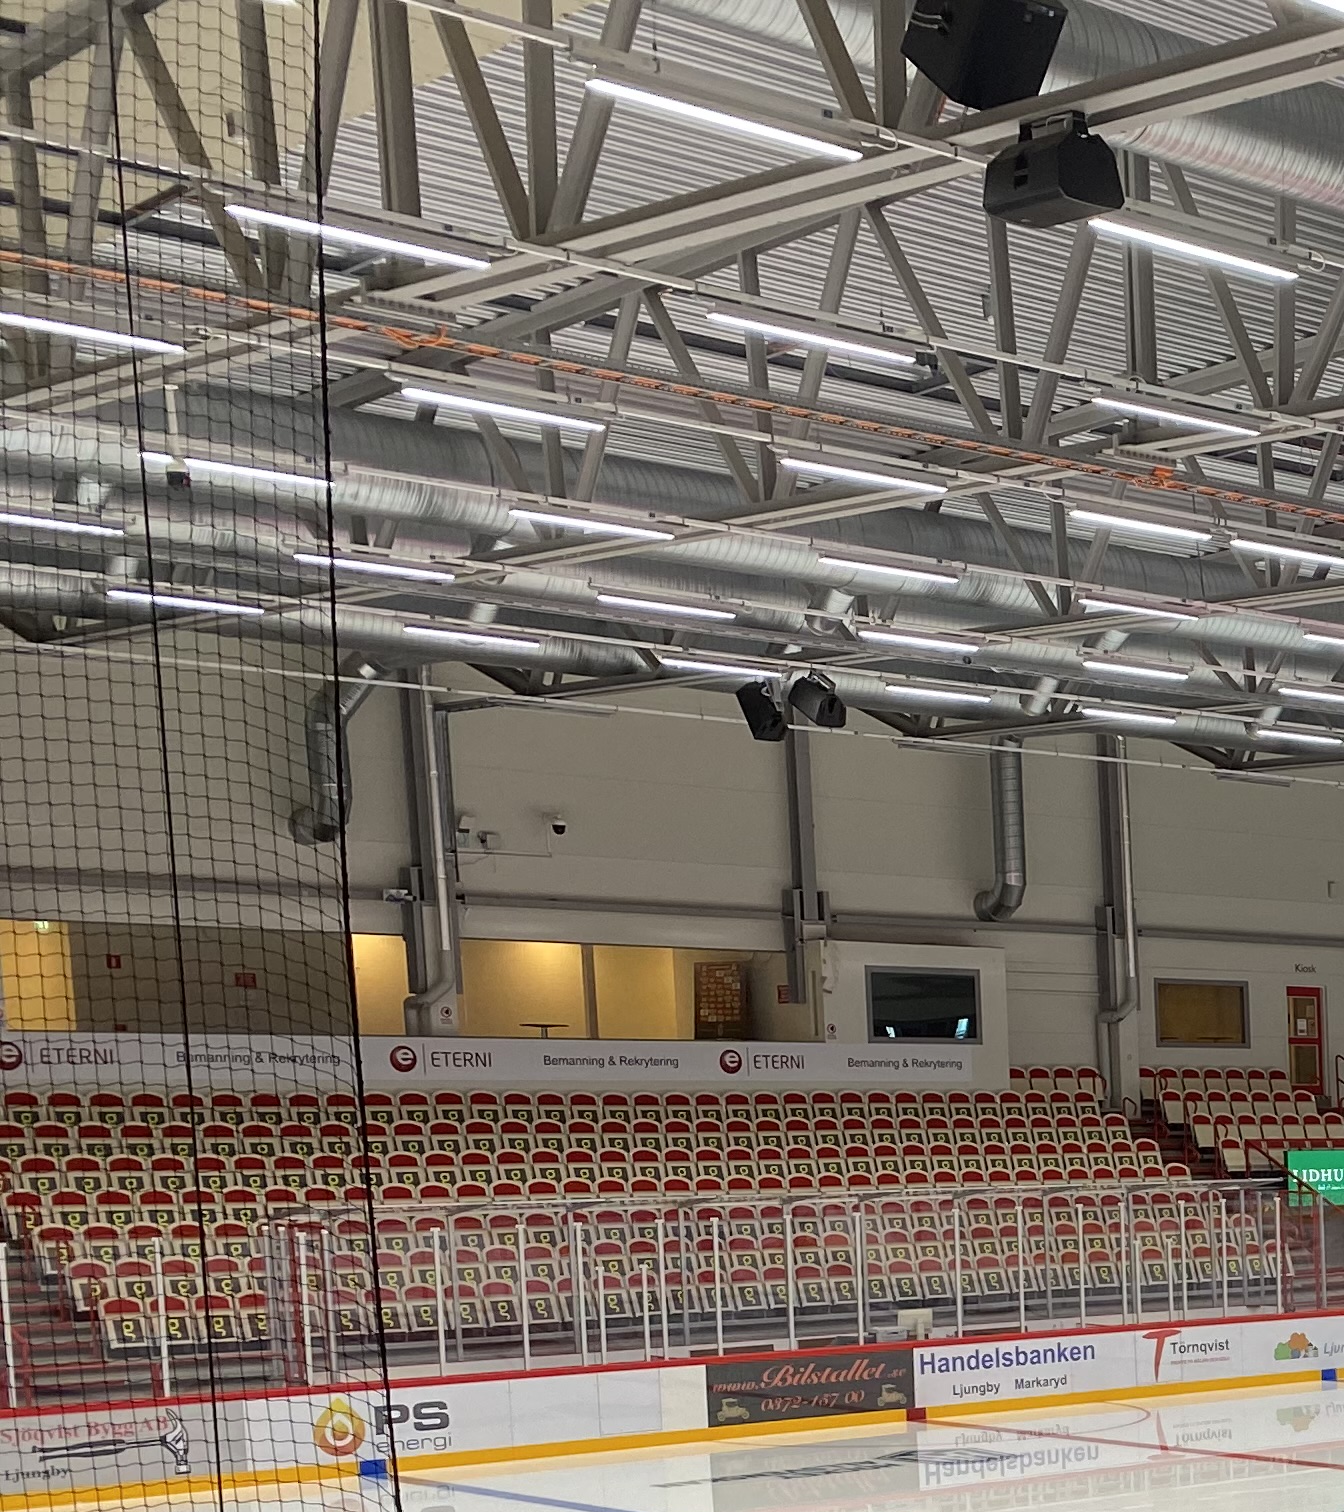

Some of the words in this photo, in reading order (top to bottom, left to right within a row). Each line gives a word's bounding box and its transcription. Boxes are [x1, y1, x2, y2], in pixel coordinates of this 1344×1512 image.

[1294, 964, 1317, 973] Kiosk
[40, 1048, 114, 1065] ETERNI
[254, 1052, 265, 1065] &
[430, 1050, 493, 1069] ETERNI
[543, 1055, 605, 1071] Bemanning
[608, 1056, 617, 1068] &
[619, 1055, 679, 1072] Rekrytering
[753, 1054, 806, 1070] ETERNI
[847, 1057, 900, 1071] Bemanning
[902, 1058, 910, 1069] &
[911, 1057, 963, 1072] Rekrytering
[1170, 1338, 1230, 1356] Törnqvist
[920, 1342, 1096, 1375] Handelsbanken
[953, 1381, 1001, 1398] Ljungby
[1014, 1374, 1068, 1391] Markaryd
[374, 1400, 450, 1436] PS
[376, 1432, 453, 1452] energi
